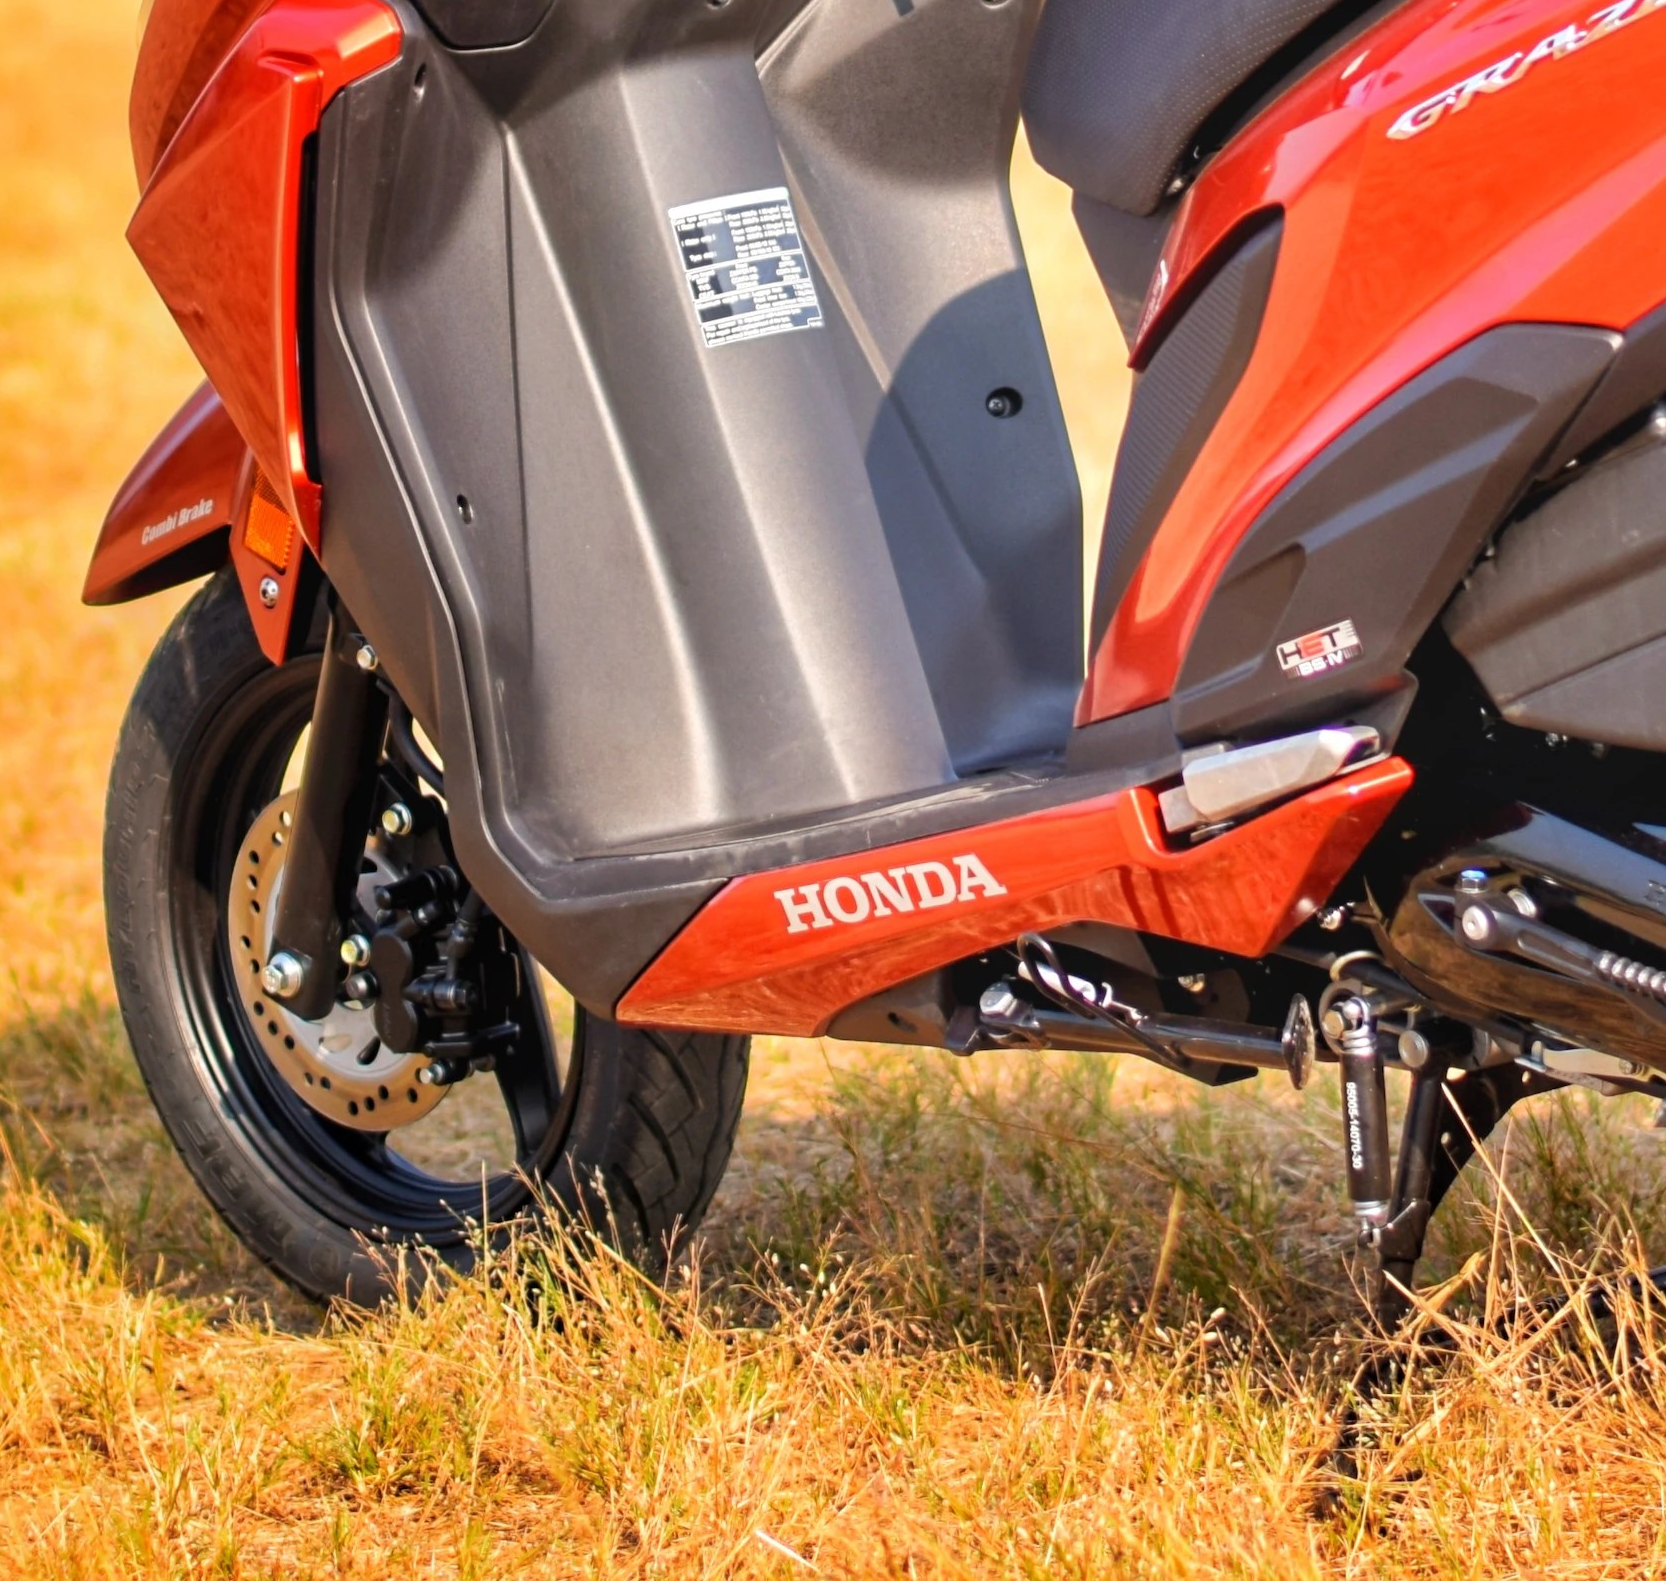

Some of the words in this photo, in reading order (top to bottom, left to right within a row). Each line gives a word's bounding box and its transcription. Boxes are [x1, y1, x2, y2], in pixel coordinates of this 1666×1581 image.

[141, 510, 177, 546] Combi
[177, 496, 214, 527] Brake
[773, 852, 1008, 935] HONDA
